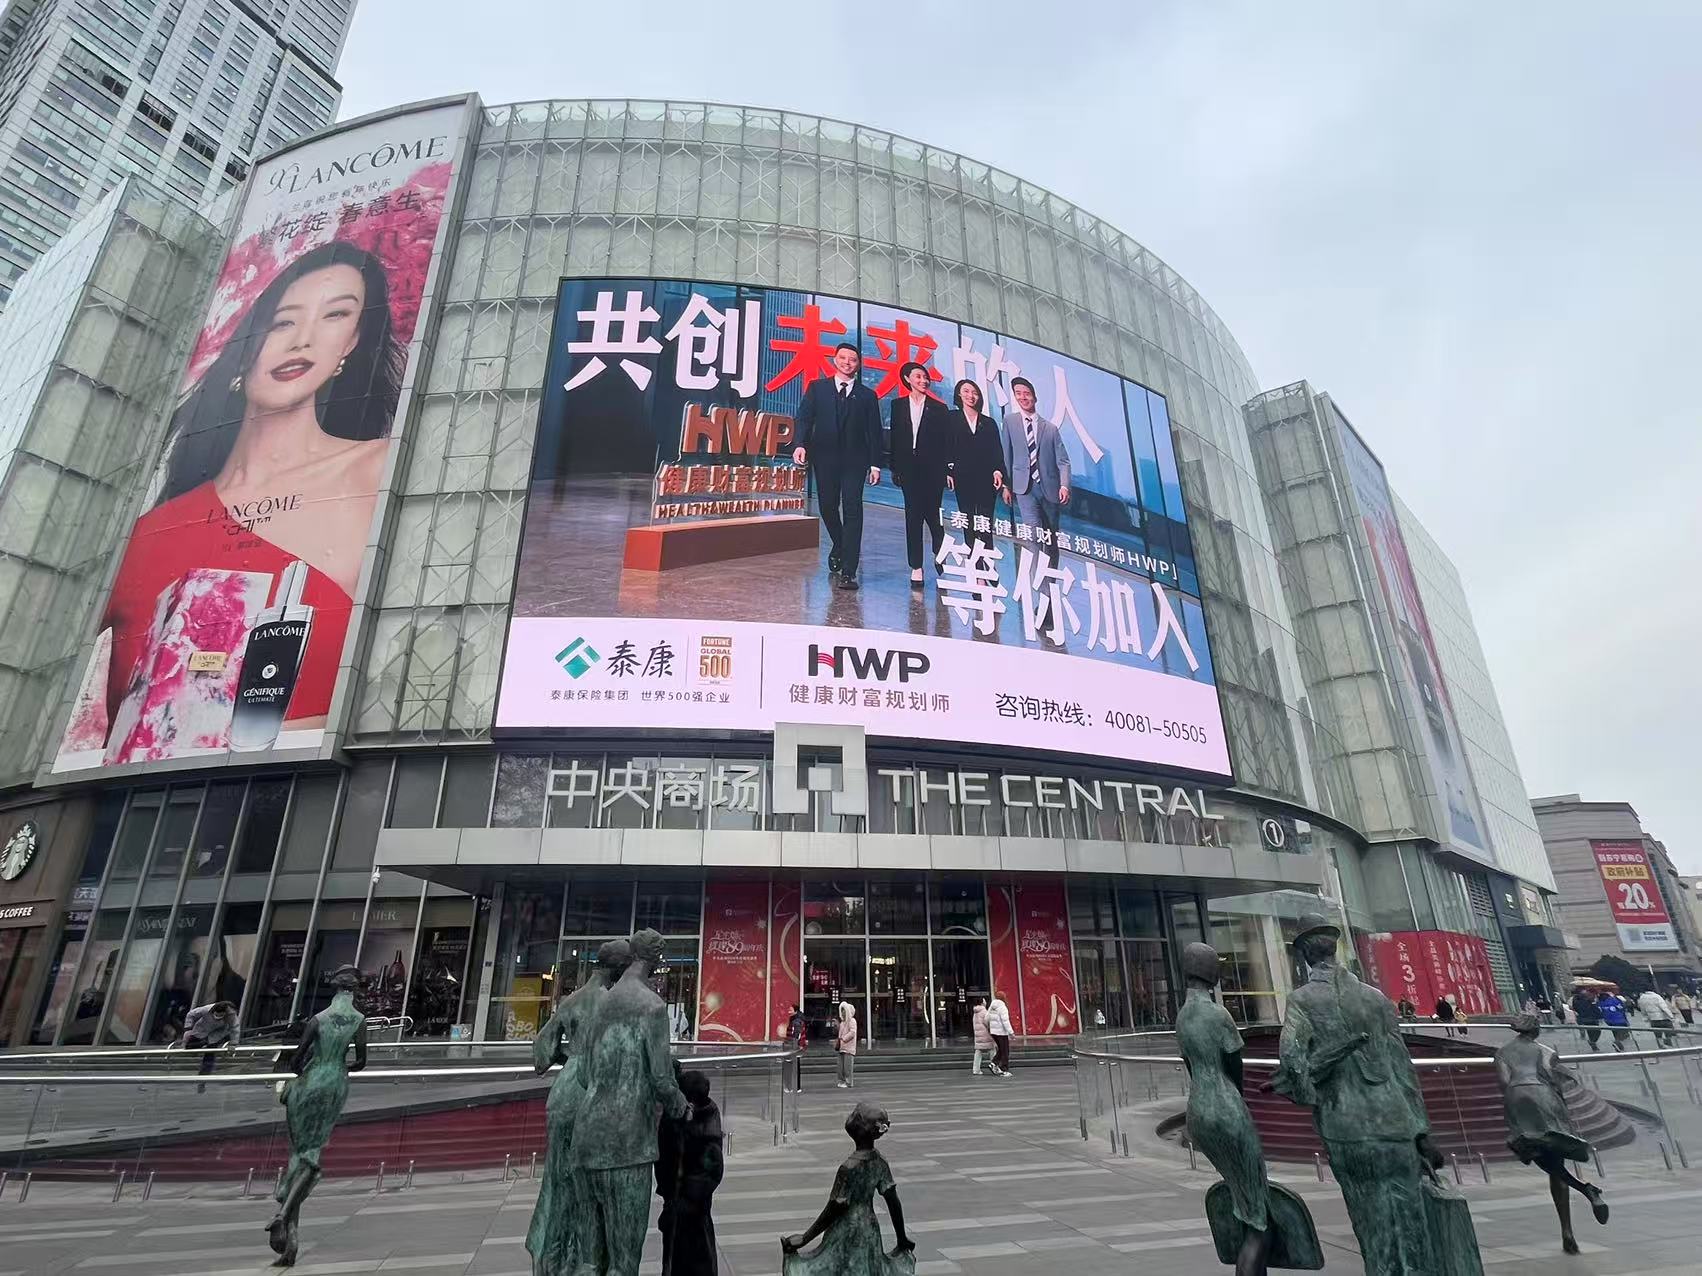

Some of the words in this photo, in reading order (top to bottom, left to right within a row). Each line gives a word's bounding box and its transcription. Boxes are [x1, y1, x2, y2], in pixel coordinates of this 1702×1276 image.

[288, 136, 448, 194] LANCÔME
[339, 190, 421, 225] 春意生
[680, 402, 795, 456] HWP
[936, 533, 1199, 672] 等你加入
[606, 640, 676, 678] 泰康
[703, 637, 731, 646] FORTUNE
[700, 655, 731, 678] 500
[808, 644, 931, 683] HWP
[550, 689, 629, 701] 泰康保险集团
[641, 690, 730, 703] 世界500强企业
[789, 683, 950, 713] 健康财富规划师
[1104, 709, 1208, 744] 40081-50505
[547, 760, 760, 812] 中央商场
[878, 769, 991, 806] THE
[1000, 774, 1224, 820] CENTRAL
[4, 906, 33, 918] COFFEE
